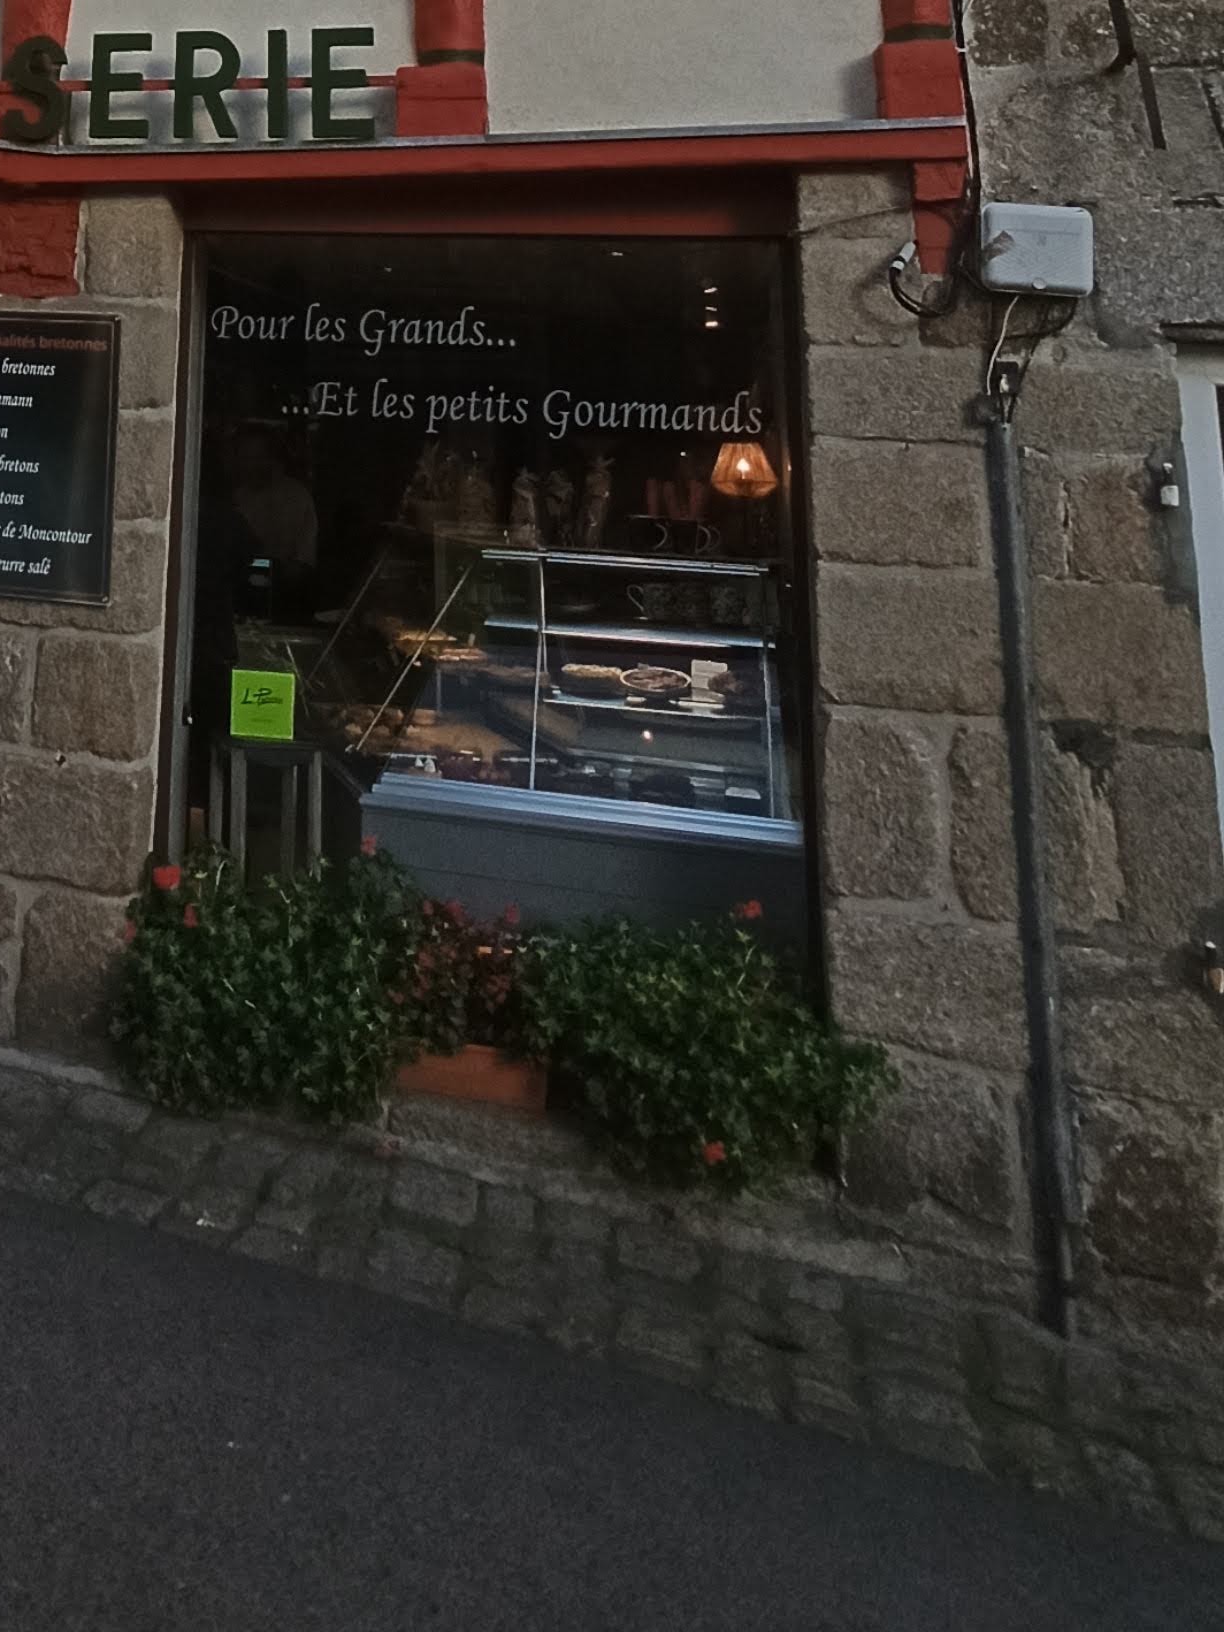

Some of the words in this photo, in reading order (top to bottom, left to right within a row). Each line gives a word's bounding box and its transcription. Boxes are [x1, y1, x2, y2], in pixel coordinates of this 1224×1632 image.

[211, 305, 295, 340] Pour
[304, 302, 347, 343] les
[359, 305, 516, 356] Grands...
[39, 334, 108, 351] bretonnes
[2, 357, 56, 376] bretonnes
[281, 380, 359, 417] ...Et
[371, 378, 415, 419] les
[426, 385, 529, 434] petits
[543, 389, 763, 440] Gourmands
[2, 520, 16, 538] de
[18, 524, 92, 544] Moncontour
[27, 557, 51, 575] salé
